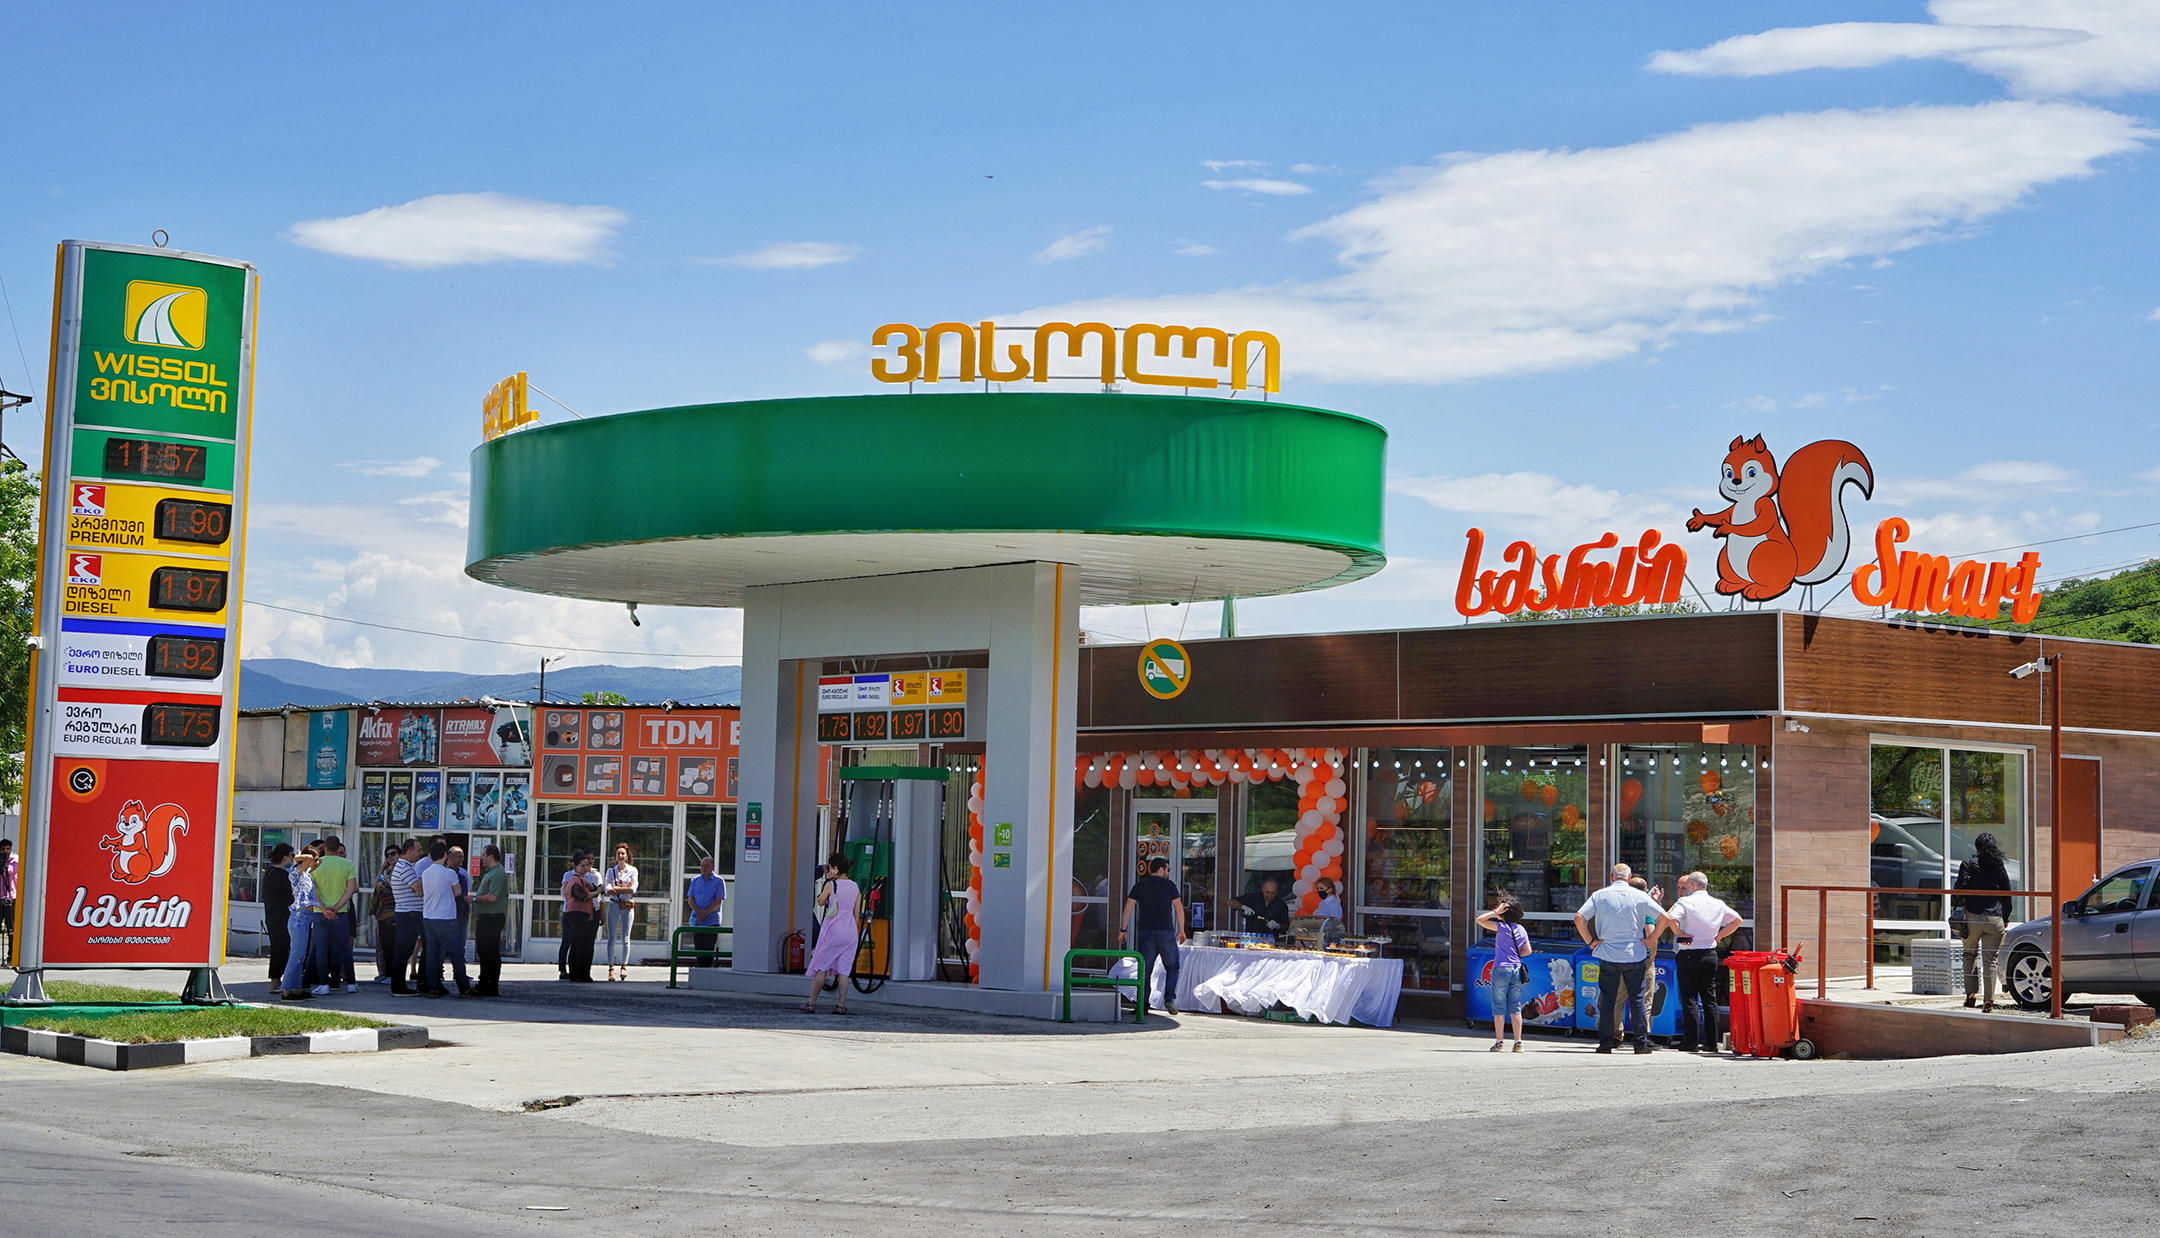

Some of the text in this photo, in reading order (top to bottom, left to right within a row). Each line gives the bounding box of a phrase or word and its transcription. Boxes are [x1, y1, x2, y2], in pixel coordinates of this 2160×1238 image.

[871, 321, 1281, 393] ვისოლი
[93, 351, 228, 387] WISSOL
[90, 377, 227, 413] ვისოლი
[118, 440, 200, 473] 11:57
[71, 517, 145, 533] პრემიუმი
[165, 506, 224, 537] 1.90
[70, 531, 144, 546] PREMIUM
[1851, 516, 2044, 625] Smart
[66, 586, 131, 601] დიზელი
[161, 574, 221, 603] 1.97
[66, 601, 118, 614] DIESEL
[68, 648, 143, 661] ევრო დიზელი
[158, 643, 217, 672] 1.92
[68, 664, 142, 676] EURO DIESEL
[66, 706, 102, 719] ევრო
[930, 711, 962, 734] 1.90
[65, 720, 137, 734] რეგულარი
[154, 711, 213, 740] 1.75
[359, 717, 393, 738] Akfix
[445, 720, 487, 735] RTRMAX
[646, 720, 713, 745] TDM
[820, 716, 849, 737] 1.75
[855, 714, 885, 736] 1.92
[892, 713, 923, 735] 1.97
[63, 734, 137, 745] EURO REGULAR
